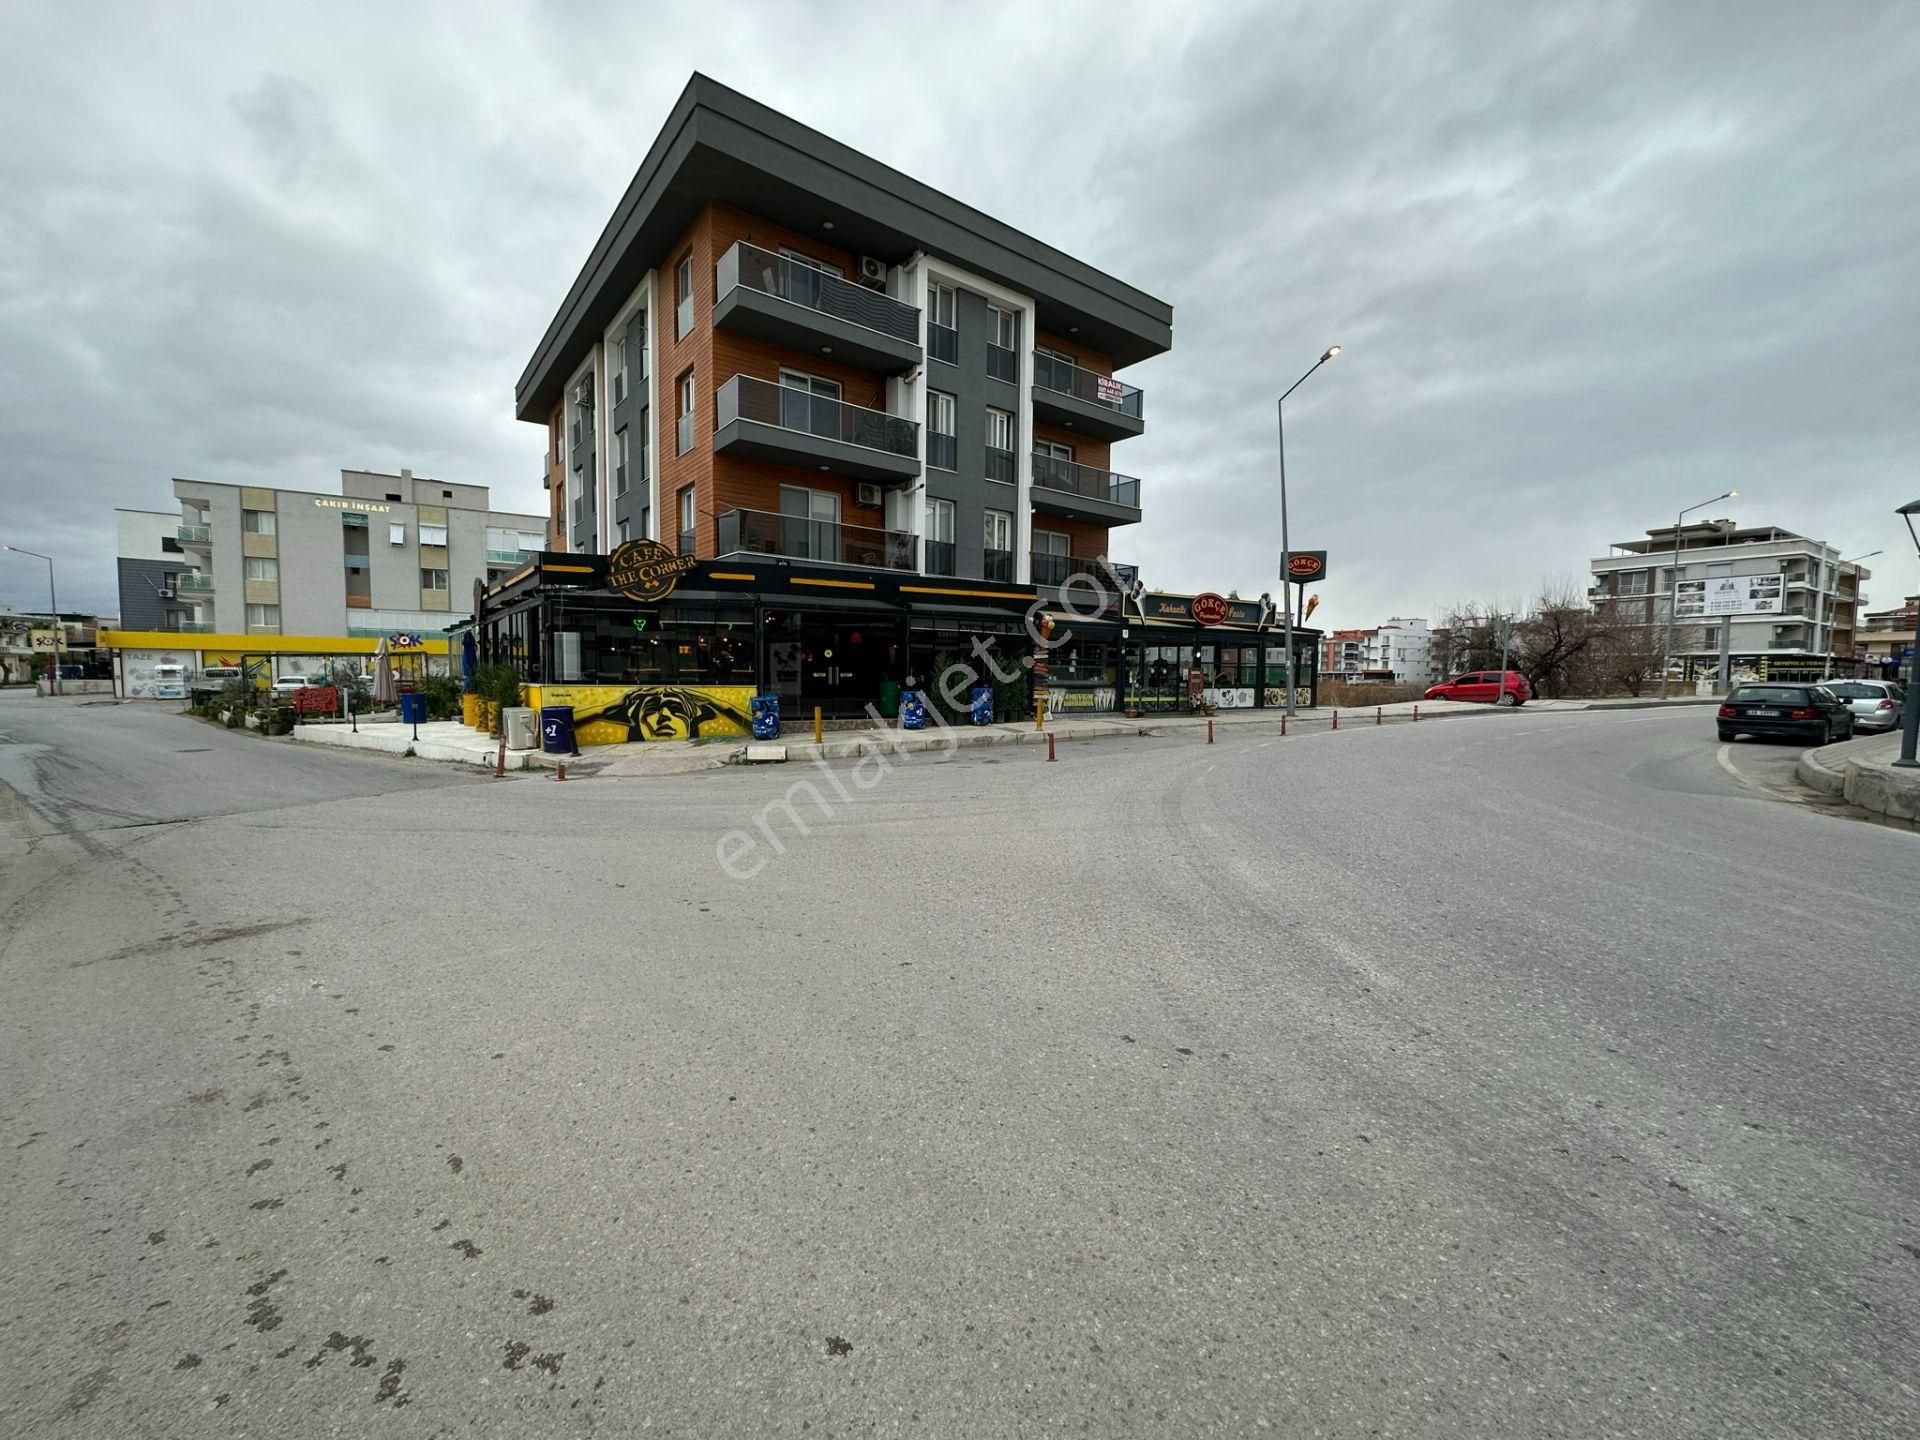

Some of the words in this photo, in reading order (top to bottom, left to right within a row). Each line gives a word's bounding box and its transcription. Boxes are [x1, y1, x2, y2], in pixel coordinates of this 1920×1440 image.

[315, 499, 348, 509] ÇAKIR
[352, 501, 391, 513] İNŞAAT
[619, 547, 663, 568] CAFE
[609, 570, 639, 587] THE
[639, 556, 697, 581] CORNER
[1194, 598, 1226, 616] GÖKÇE
[389, 630, 424, 650] ŞOK
[127, 653, 153, 661] TAZE
[545, 724, 557, 736] +1
